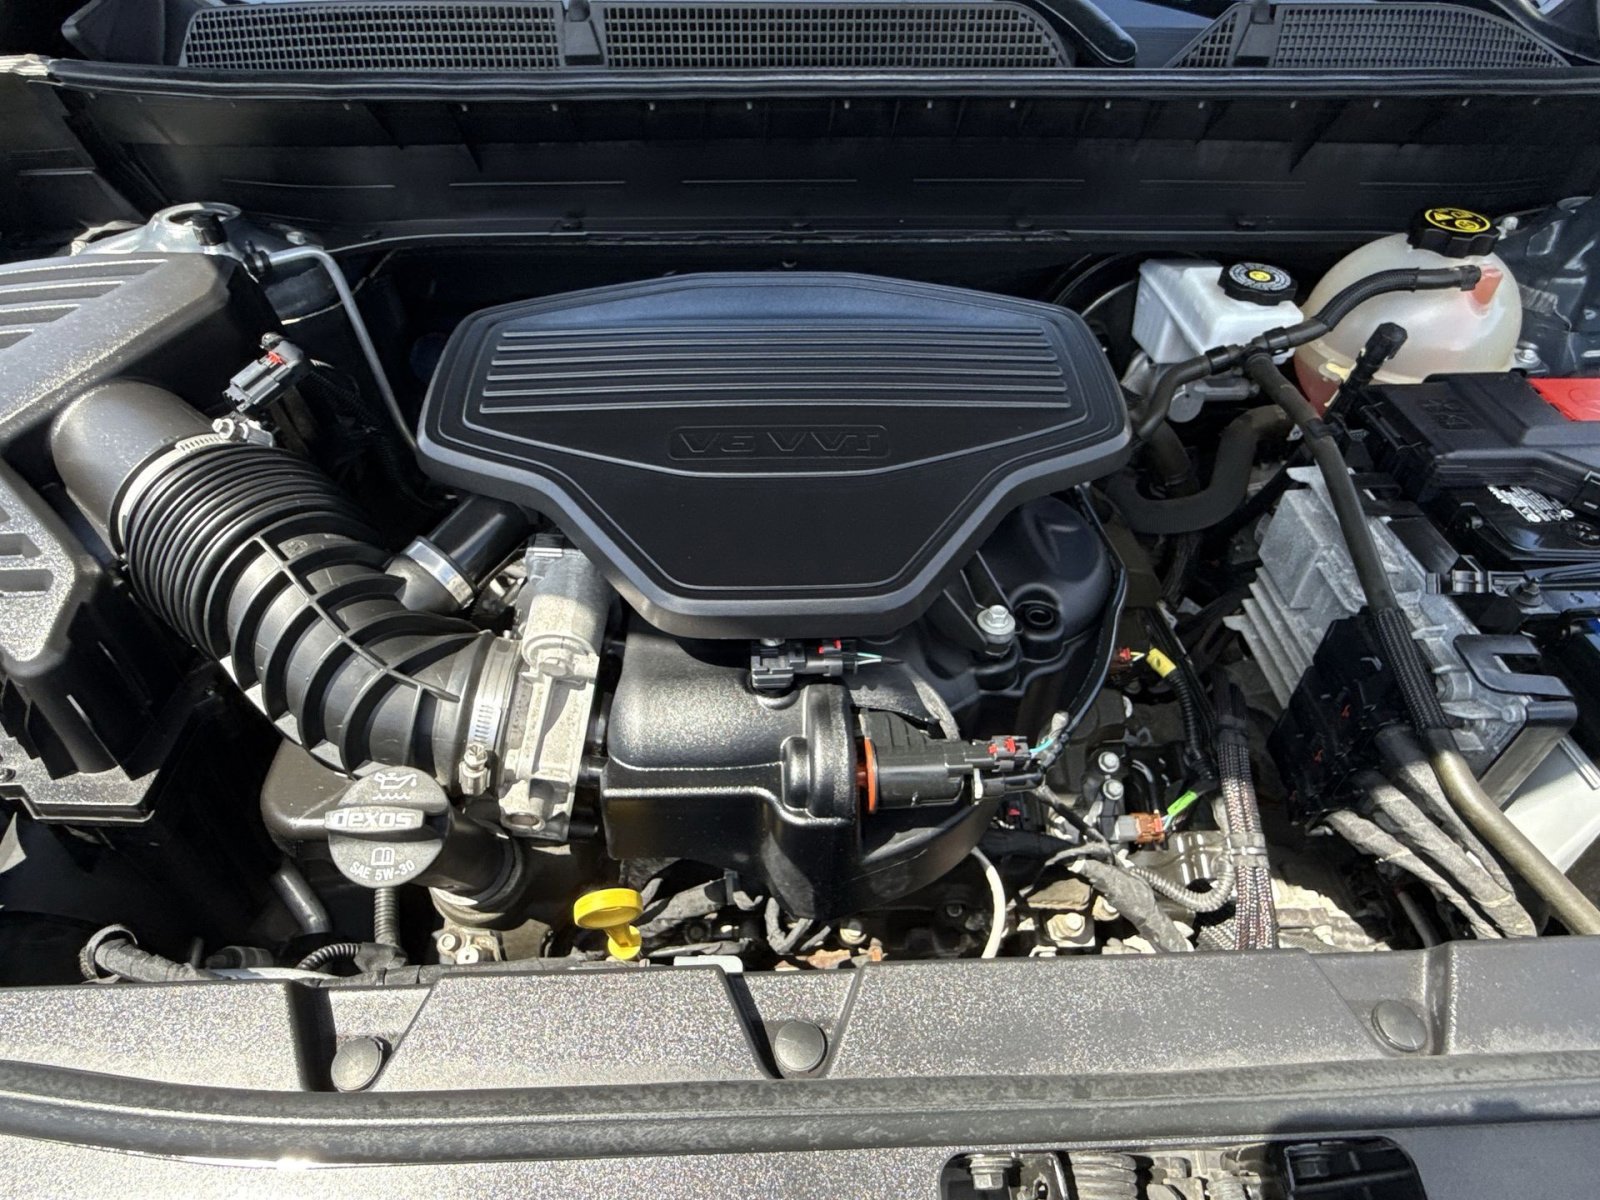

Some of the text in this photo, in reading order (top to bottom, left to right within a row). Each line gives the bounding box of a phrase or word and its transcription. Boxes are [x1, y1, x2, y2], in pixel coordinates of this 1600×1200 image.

[679, 431, 880, 453] V6 VVT
[331, 808, 416, 829] dexos
[350, 860, 415, 881] SAE 5W-30
